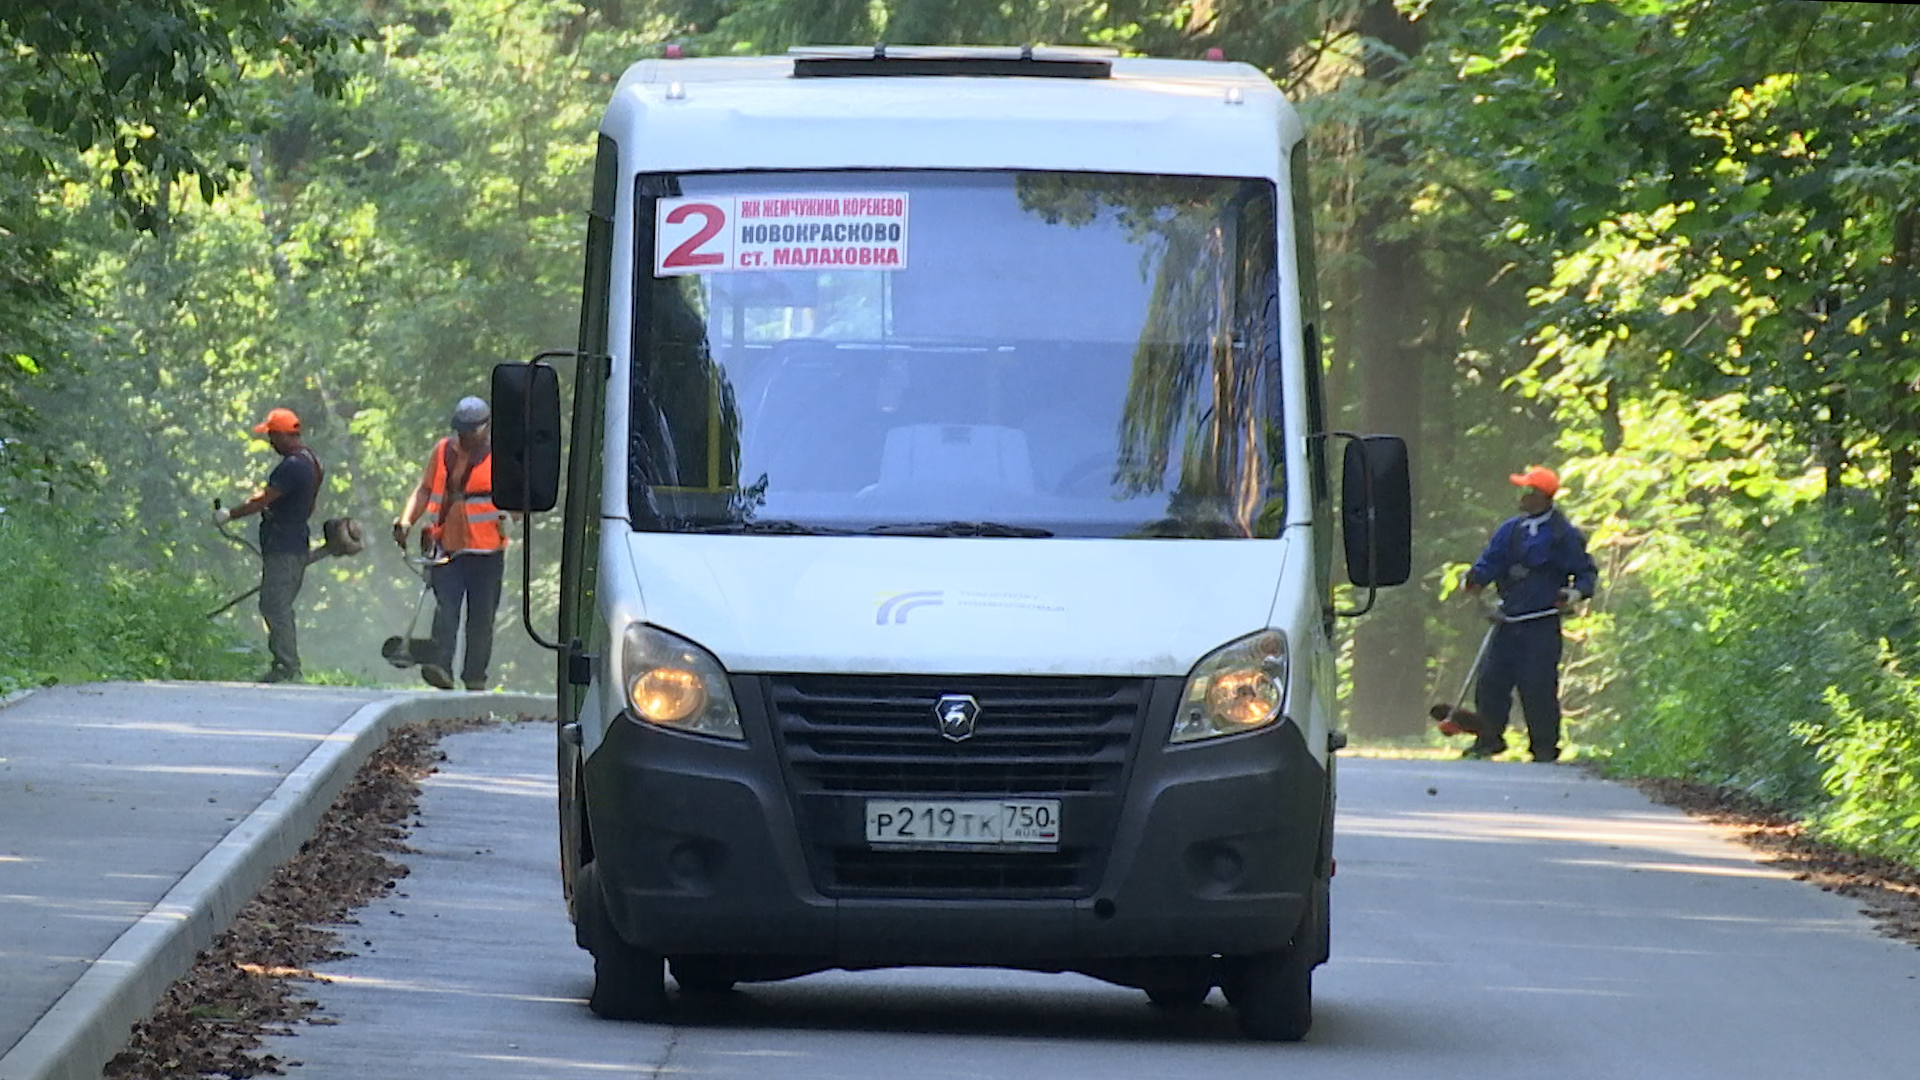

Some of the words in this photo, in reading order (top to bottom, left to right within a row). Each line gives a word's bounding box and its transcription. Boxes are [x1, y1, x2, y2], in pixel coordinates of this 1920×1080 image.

[741, 200, 760, 219] ЖК
[763, 198, 840, 218] ЖЕМЧУЖИНА
[843, 197, 903, 217] КОРЕНЕВО
[662, 203, 726, 268] 2
[741, 222, 901, 244] НОВОКРАСКОВО
[773, 246, 899, 266] МАЛАХОВКА
[1004, 805, 1050, 828] 750
